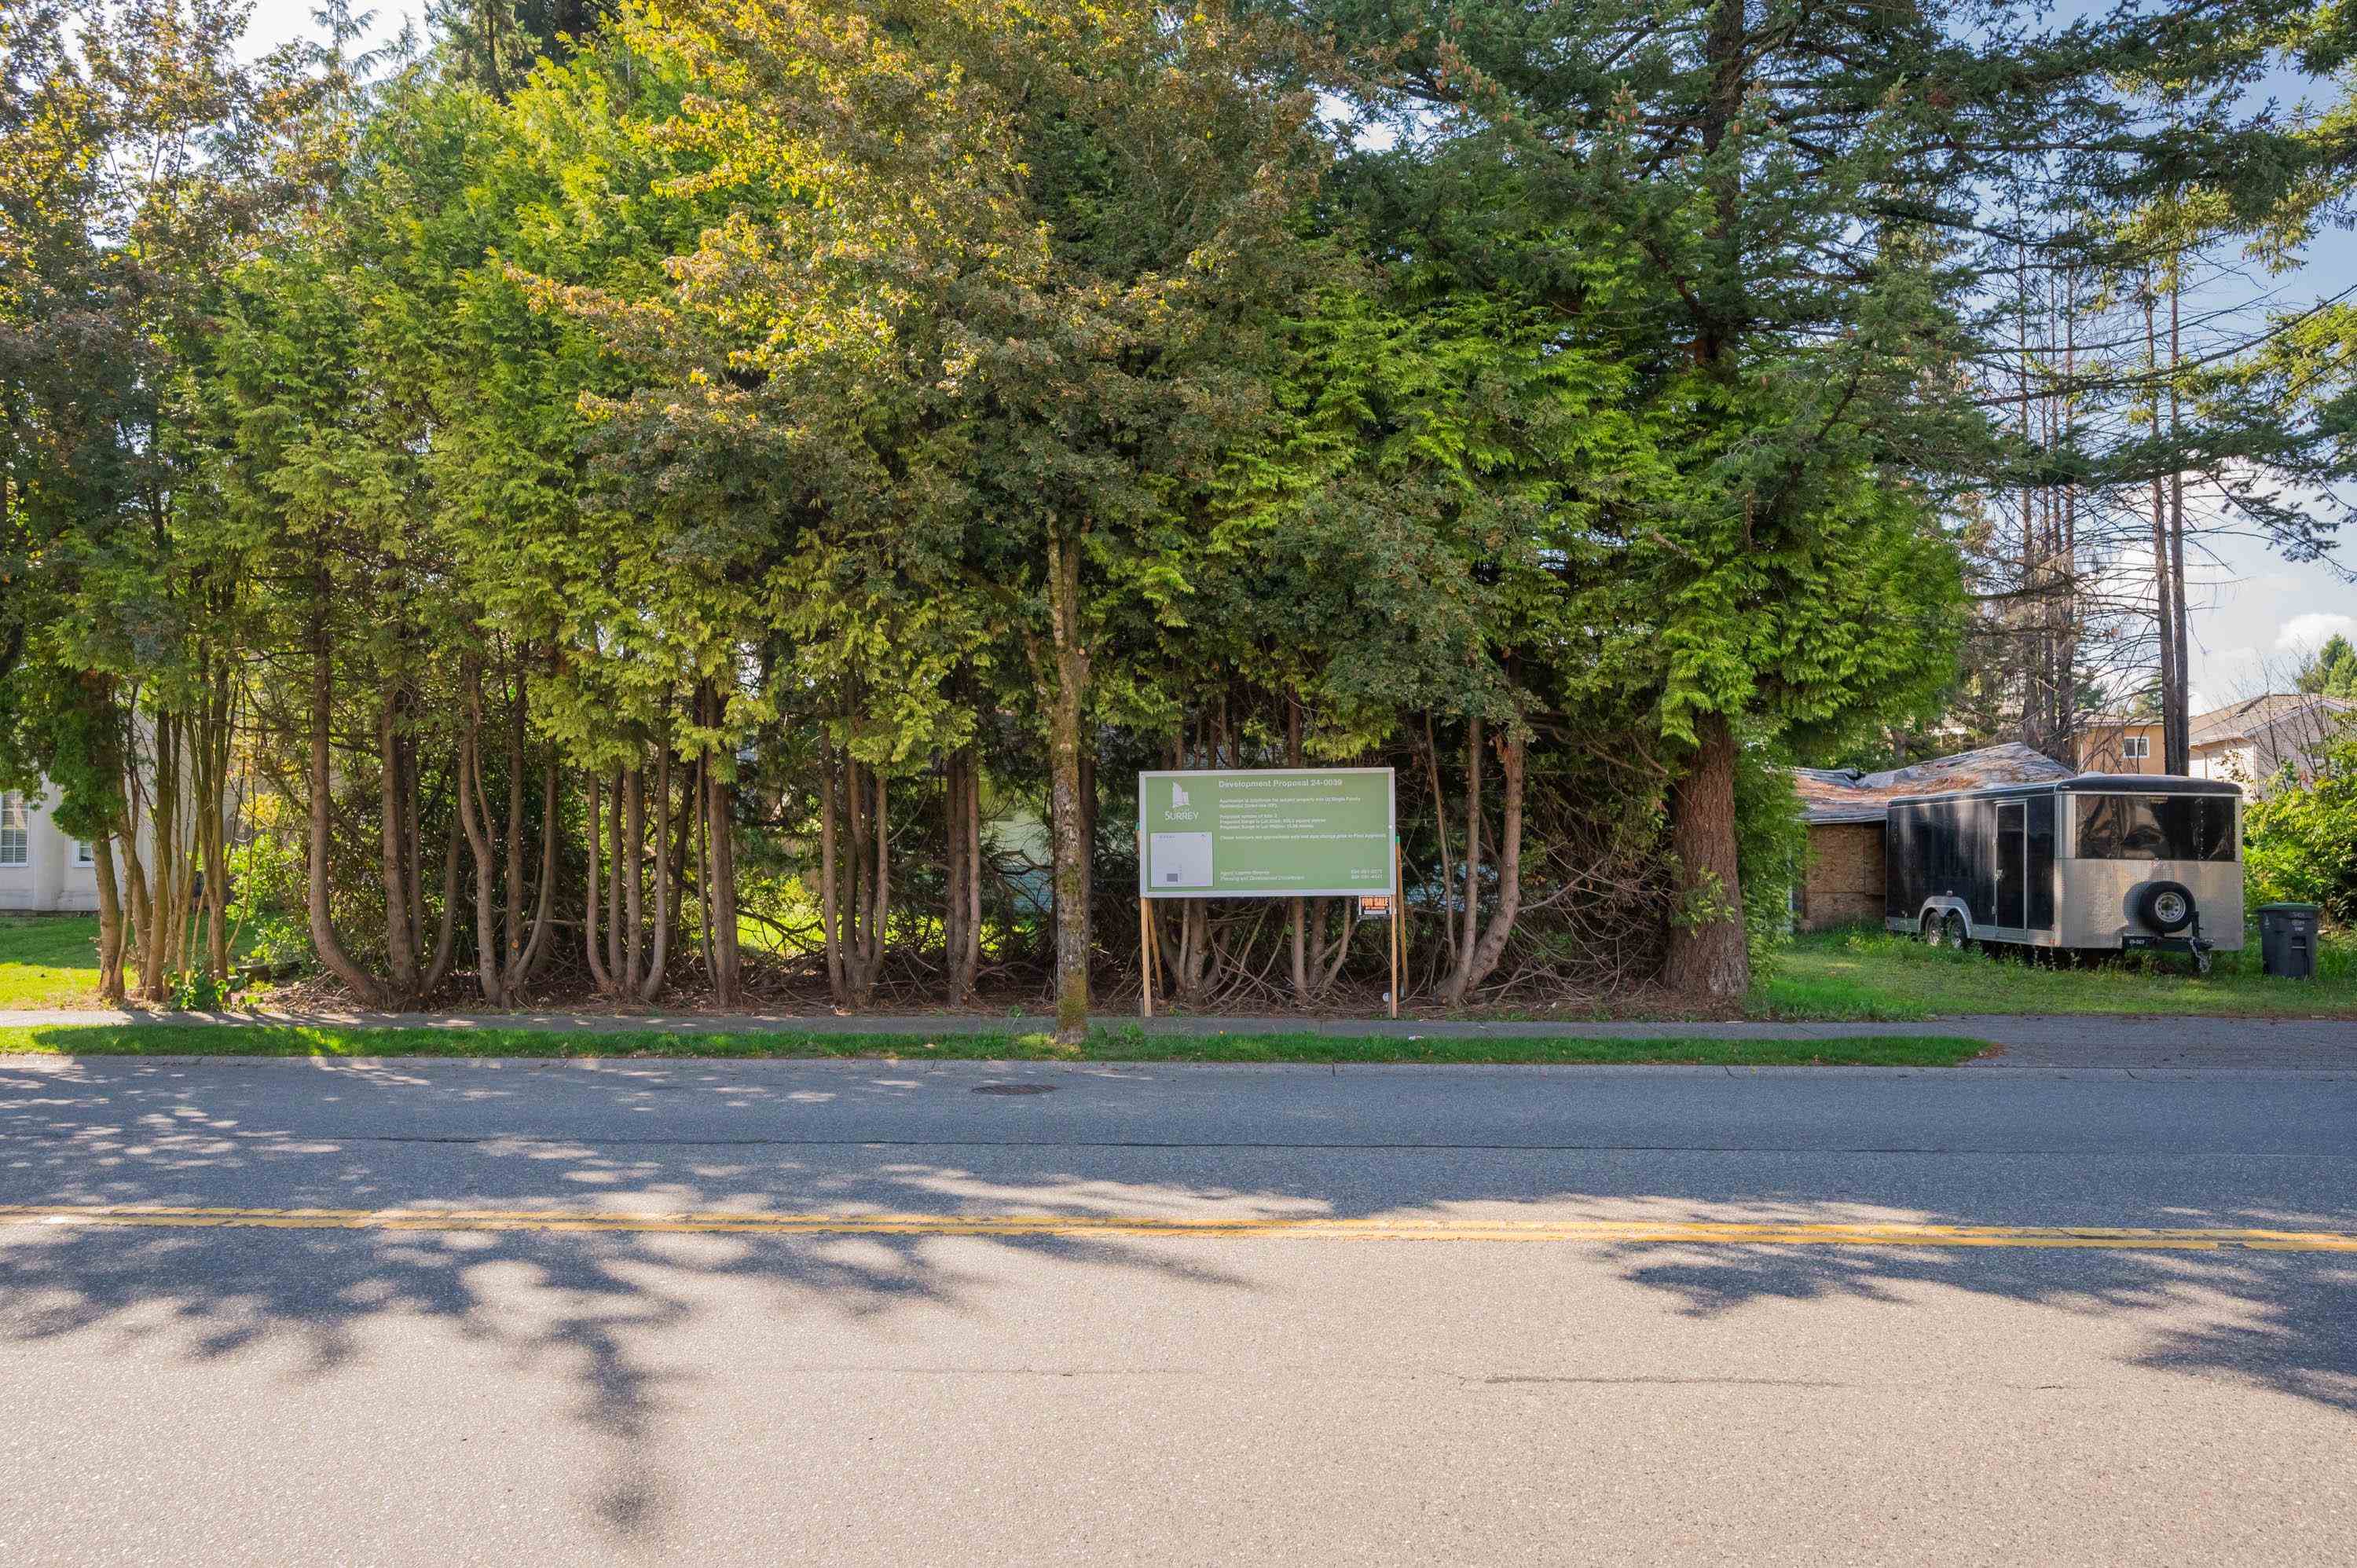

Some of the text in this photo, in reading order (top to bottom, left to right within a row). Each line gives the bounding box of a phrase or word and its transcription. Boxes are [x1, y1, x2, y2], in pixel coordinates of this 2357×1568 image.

[1219, 779, 1271, 789] Development
[1273, 779, 1309, 788] Proposal
[1164, 811, 1200, 821] SURREY
[1362, 898, 1389, 907] FOR SALE
